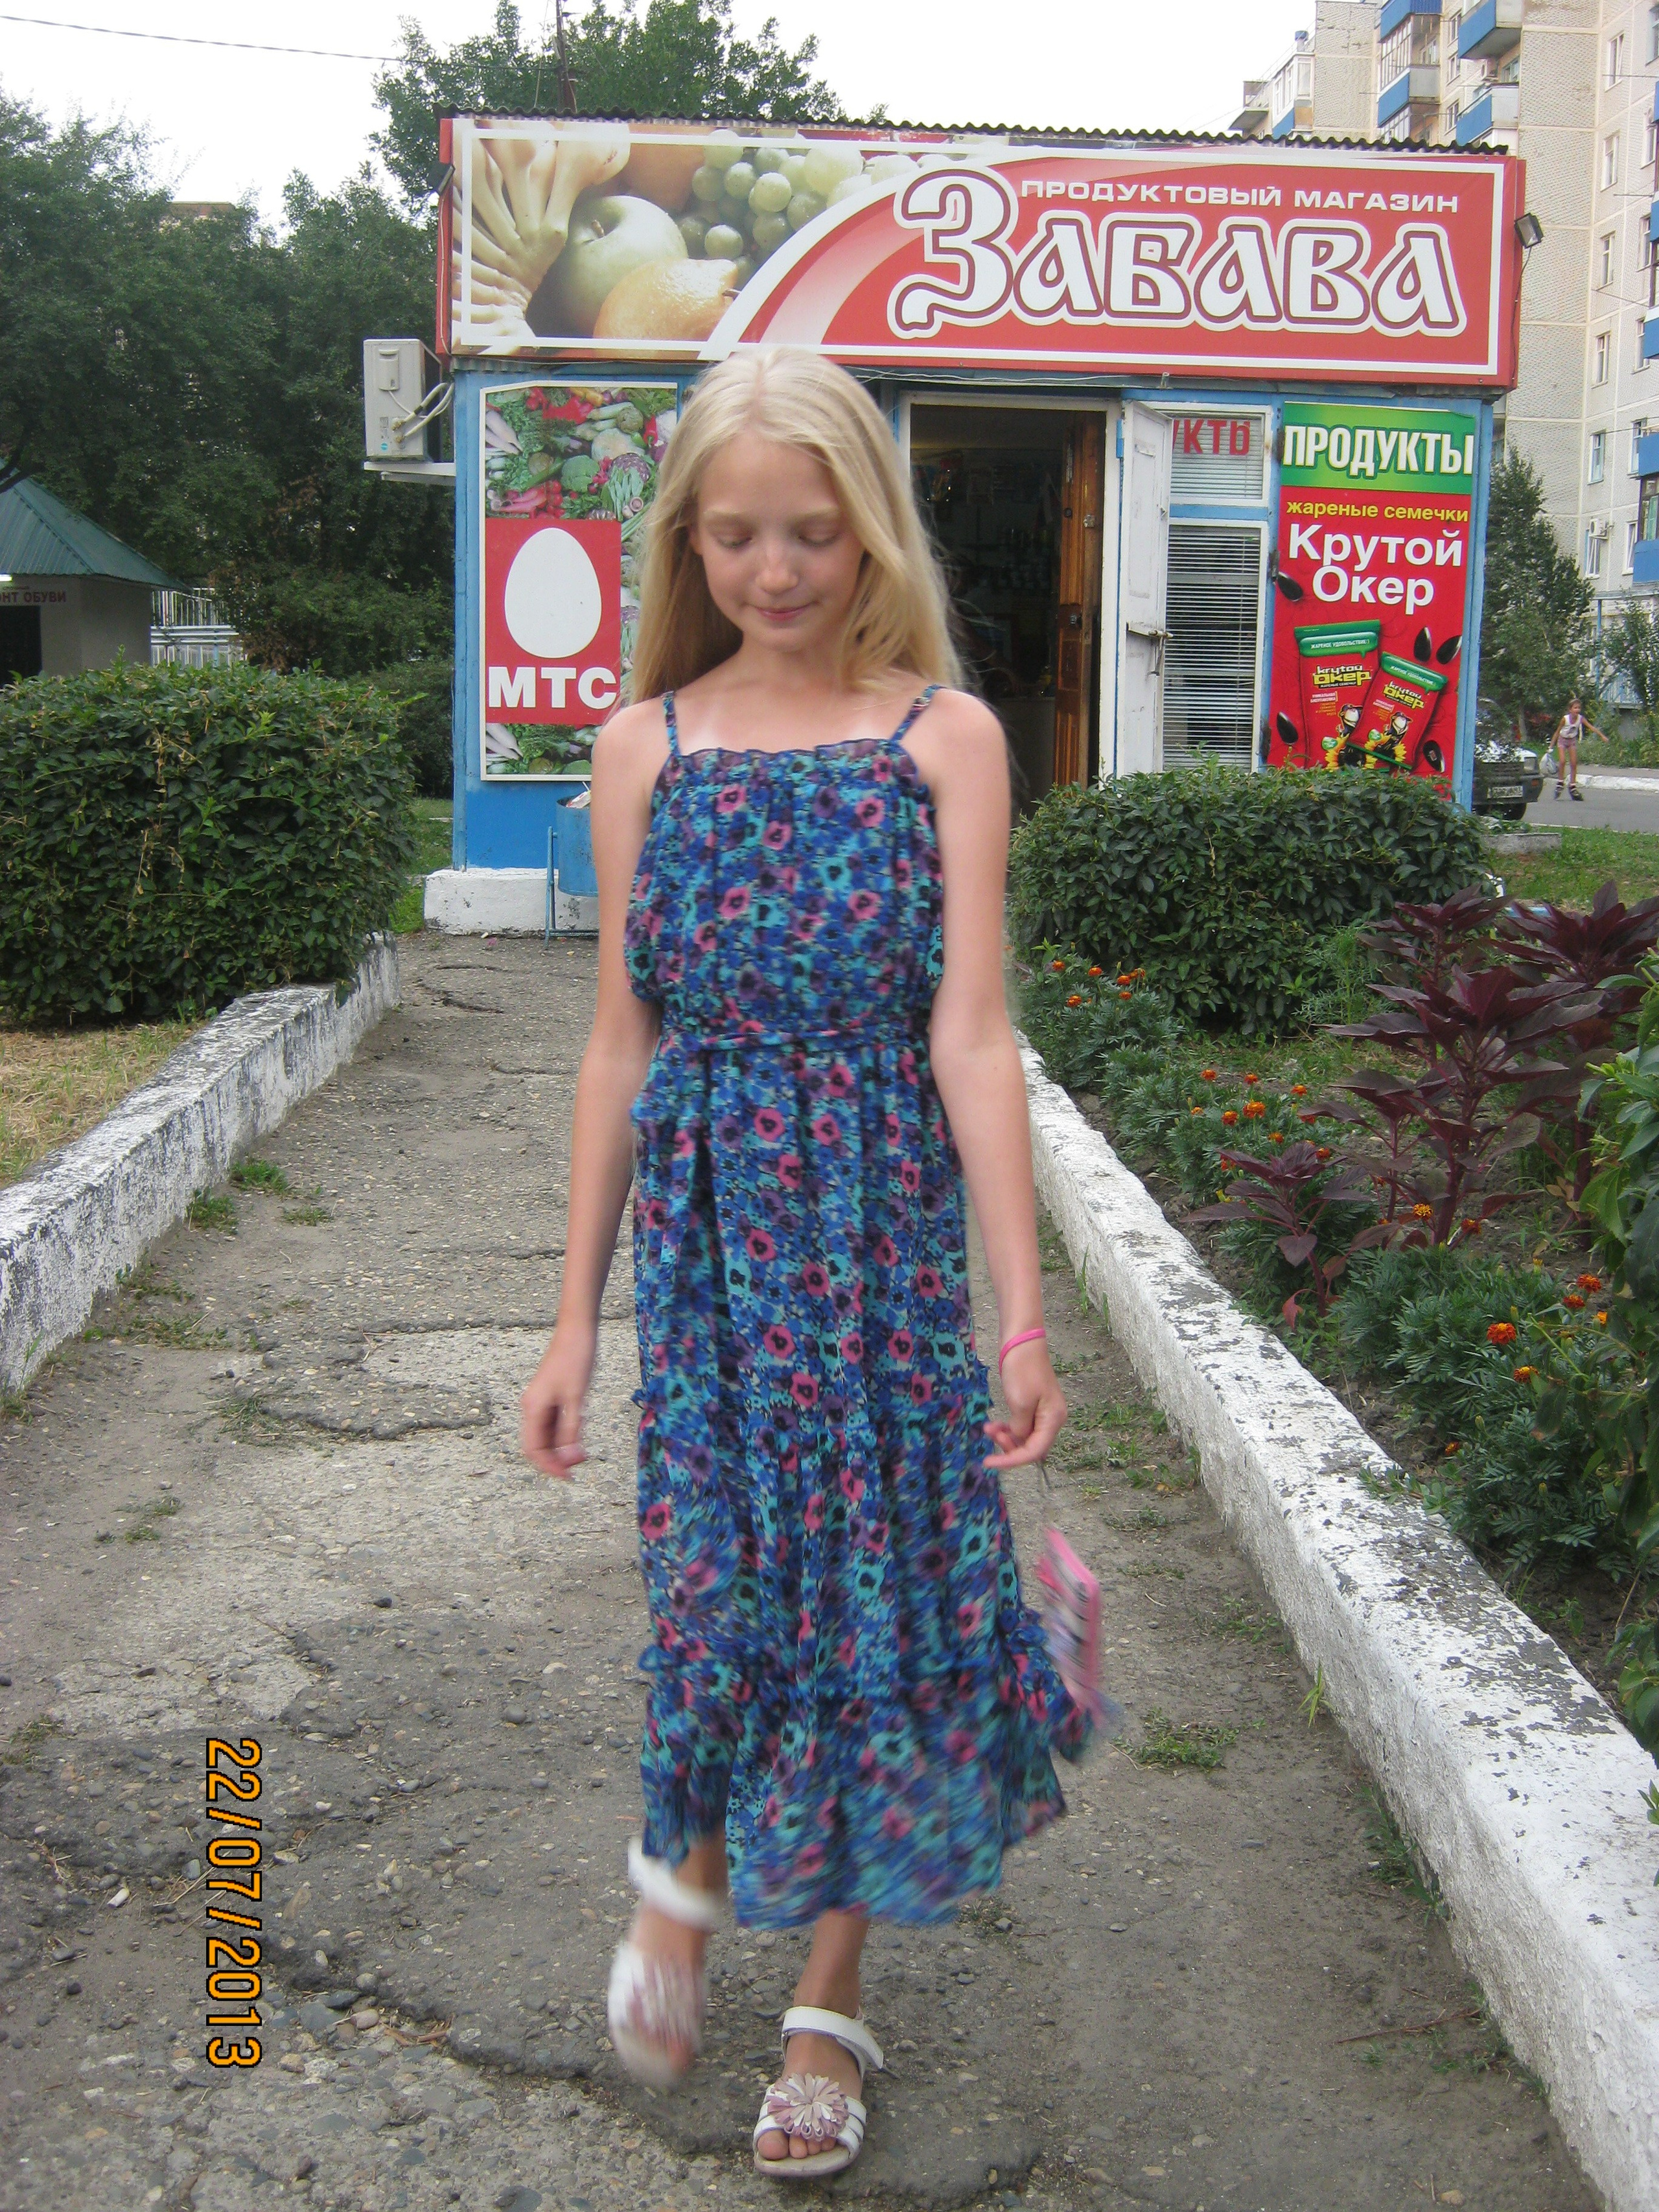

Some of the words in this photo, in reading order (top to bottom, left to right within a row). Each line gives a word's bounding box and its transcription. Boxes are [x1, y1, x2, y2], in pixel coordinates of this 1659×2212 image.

[1020, 180, 1282, 208] ПРОДУКТОВЫЙ
[1295, 189, 1459, 214] МАГАЗИН
[1282, 425, 1474, 477] ПРОДУКТЫ
[1286, 501, 1378, 518] жареные
[1384, 506, 1468, 522] семечки
[1289, 523, 1462, 572] Крутой
[24, 591, 66, 603] ОБУВИ
[1312, 565, 1435, 615] Окер
[488, 666, 618, 710] МТС
